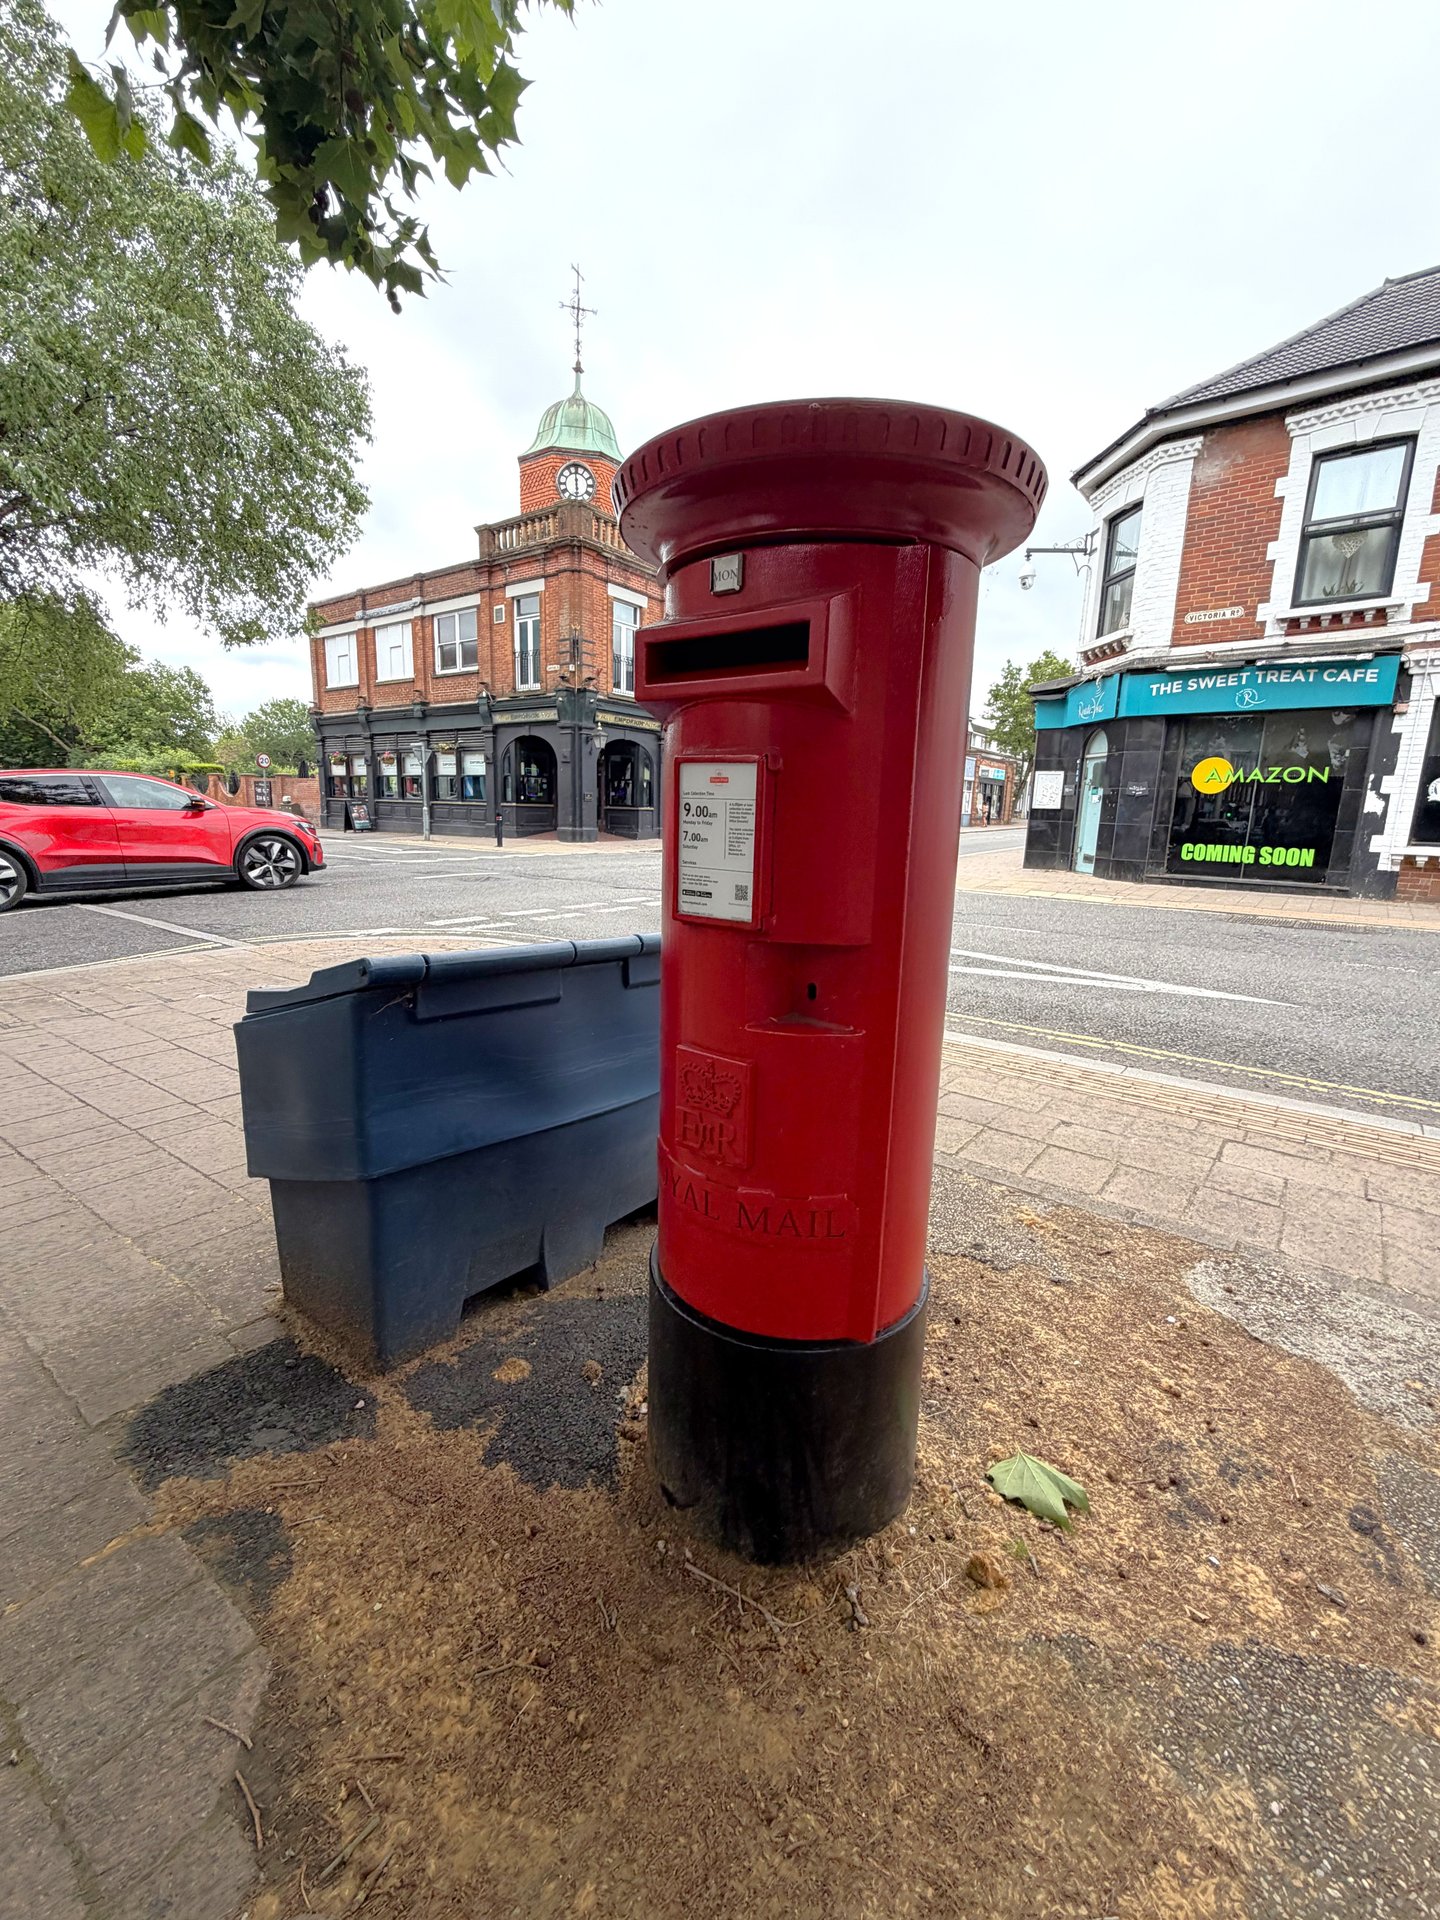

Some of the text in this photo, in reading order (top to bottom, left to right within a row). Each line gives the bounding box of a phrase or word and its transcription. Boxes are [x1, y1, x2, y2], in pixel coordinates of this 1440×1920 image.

[713, 568, 738, 582] MON
[1190, 611, 1226, 621] VICTORIA
[1149, 668, 1379, 697] THE SWEET TREAT CAFE
[1204, 766, 1330, 784] AMAZON
[683, 802, 718, 818] 9.00am
[683, 830, 709, 842] 7.00am
[1181, 843, 1316, 868] COMING SOON
[736, 1201, 846, 1239] MAIL
